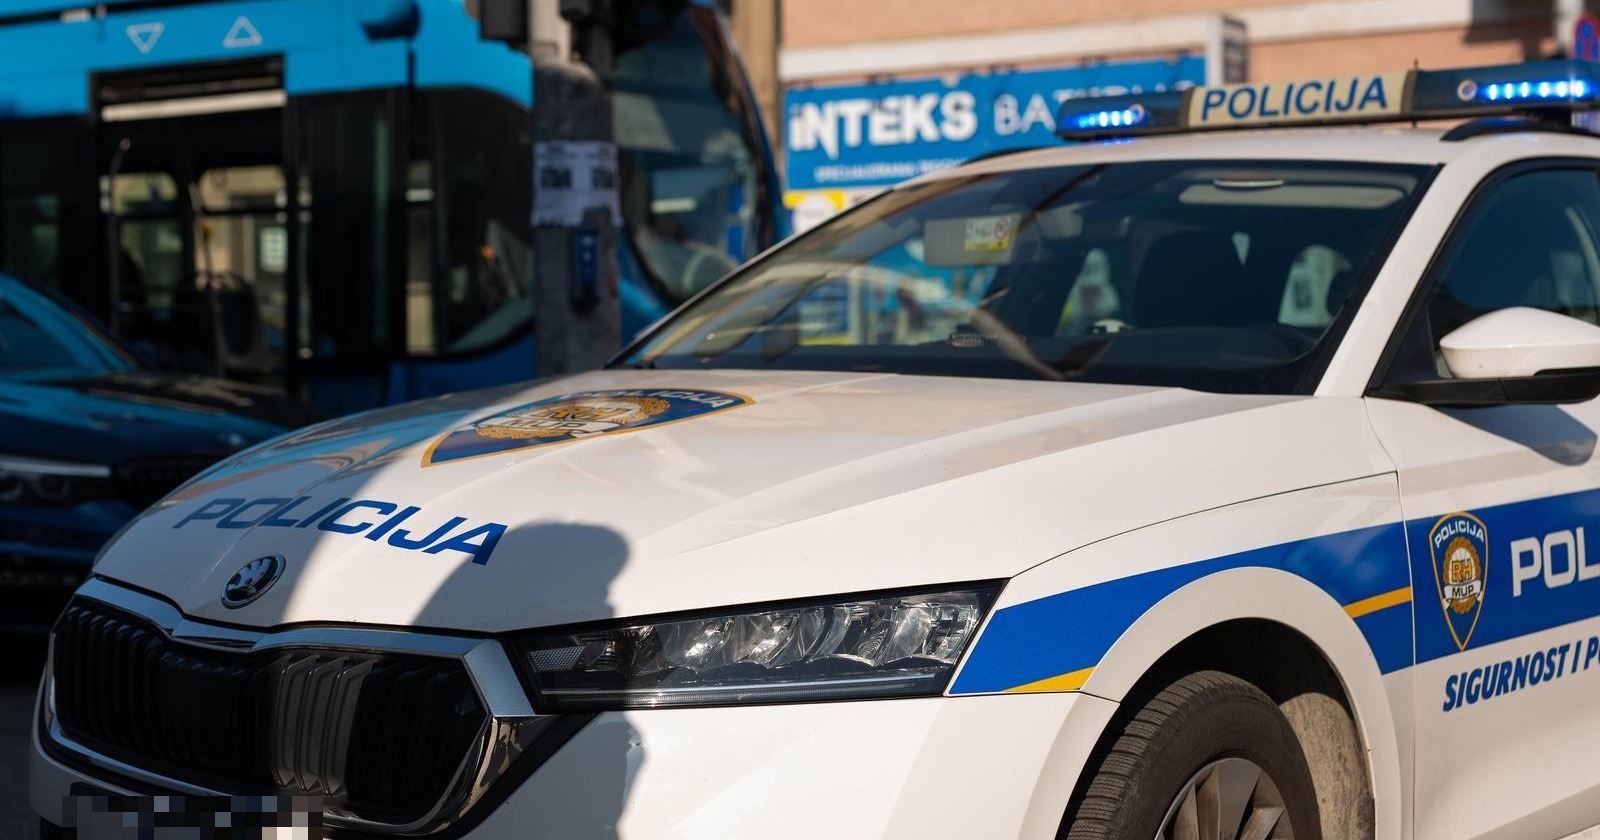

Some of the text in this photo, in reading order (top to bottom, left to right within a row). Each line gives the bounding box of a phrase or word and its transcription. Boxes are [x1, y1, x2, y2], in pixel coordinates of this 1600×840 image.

[1202, 76, 1388, 121] POLICIJA
[500, 418, 588, 429] MUP
[171, 497, 508, 565] POLICIJA
[1434, 520, 1484, 548] POLICIJA
[1452, 559, 1473, 582] RH
[1511, 526, 1600, 597] POL
[1452, 585, 1474, 598] MUP
[1443, 635, 1600, 712] SIGURNOST I P
